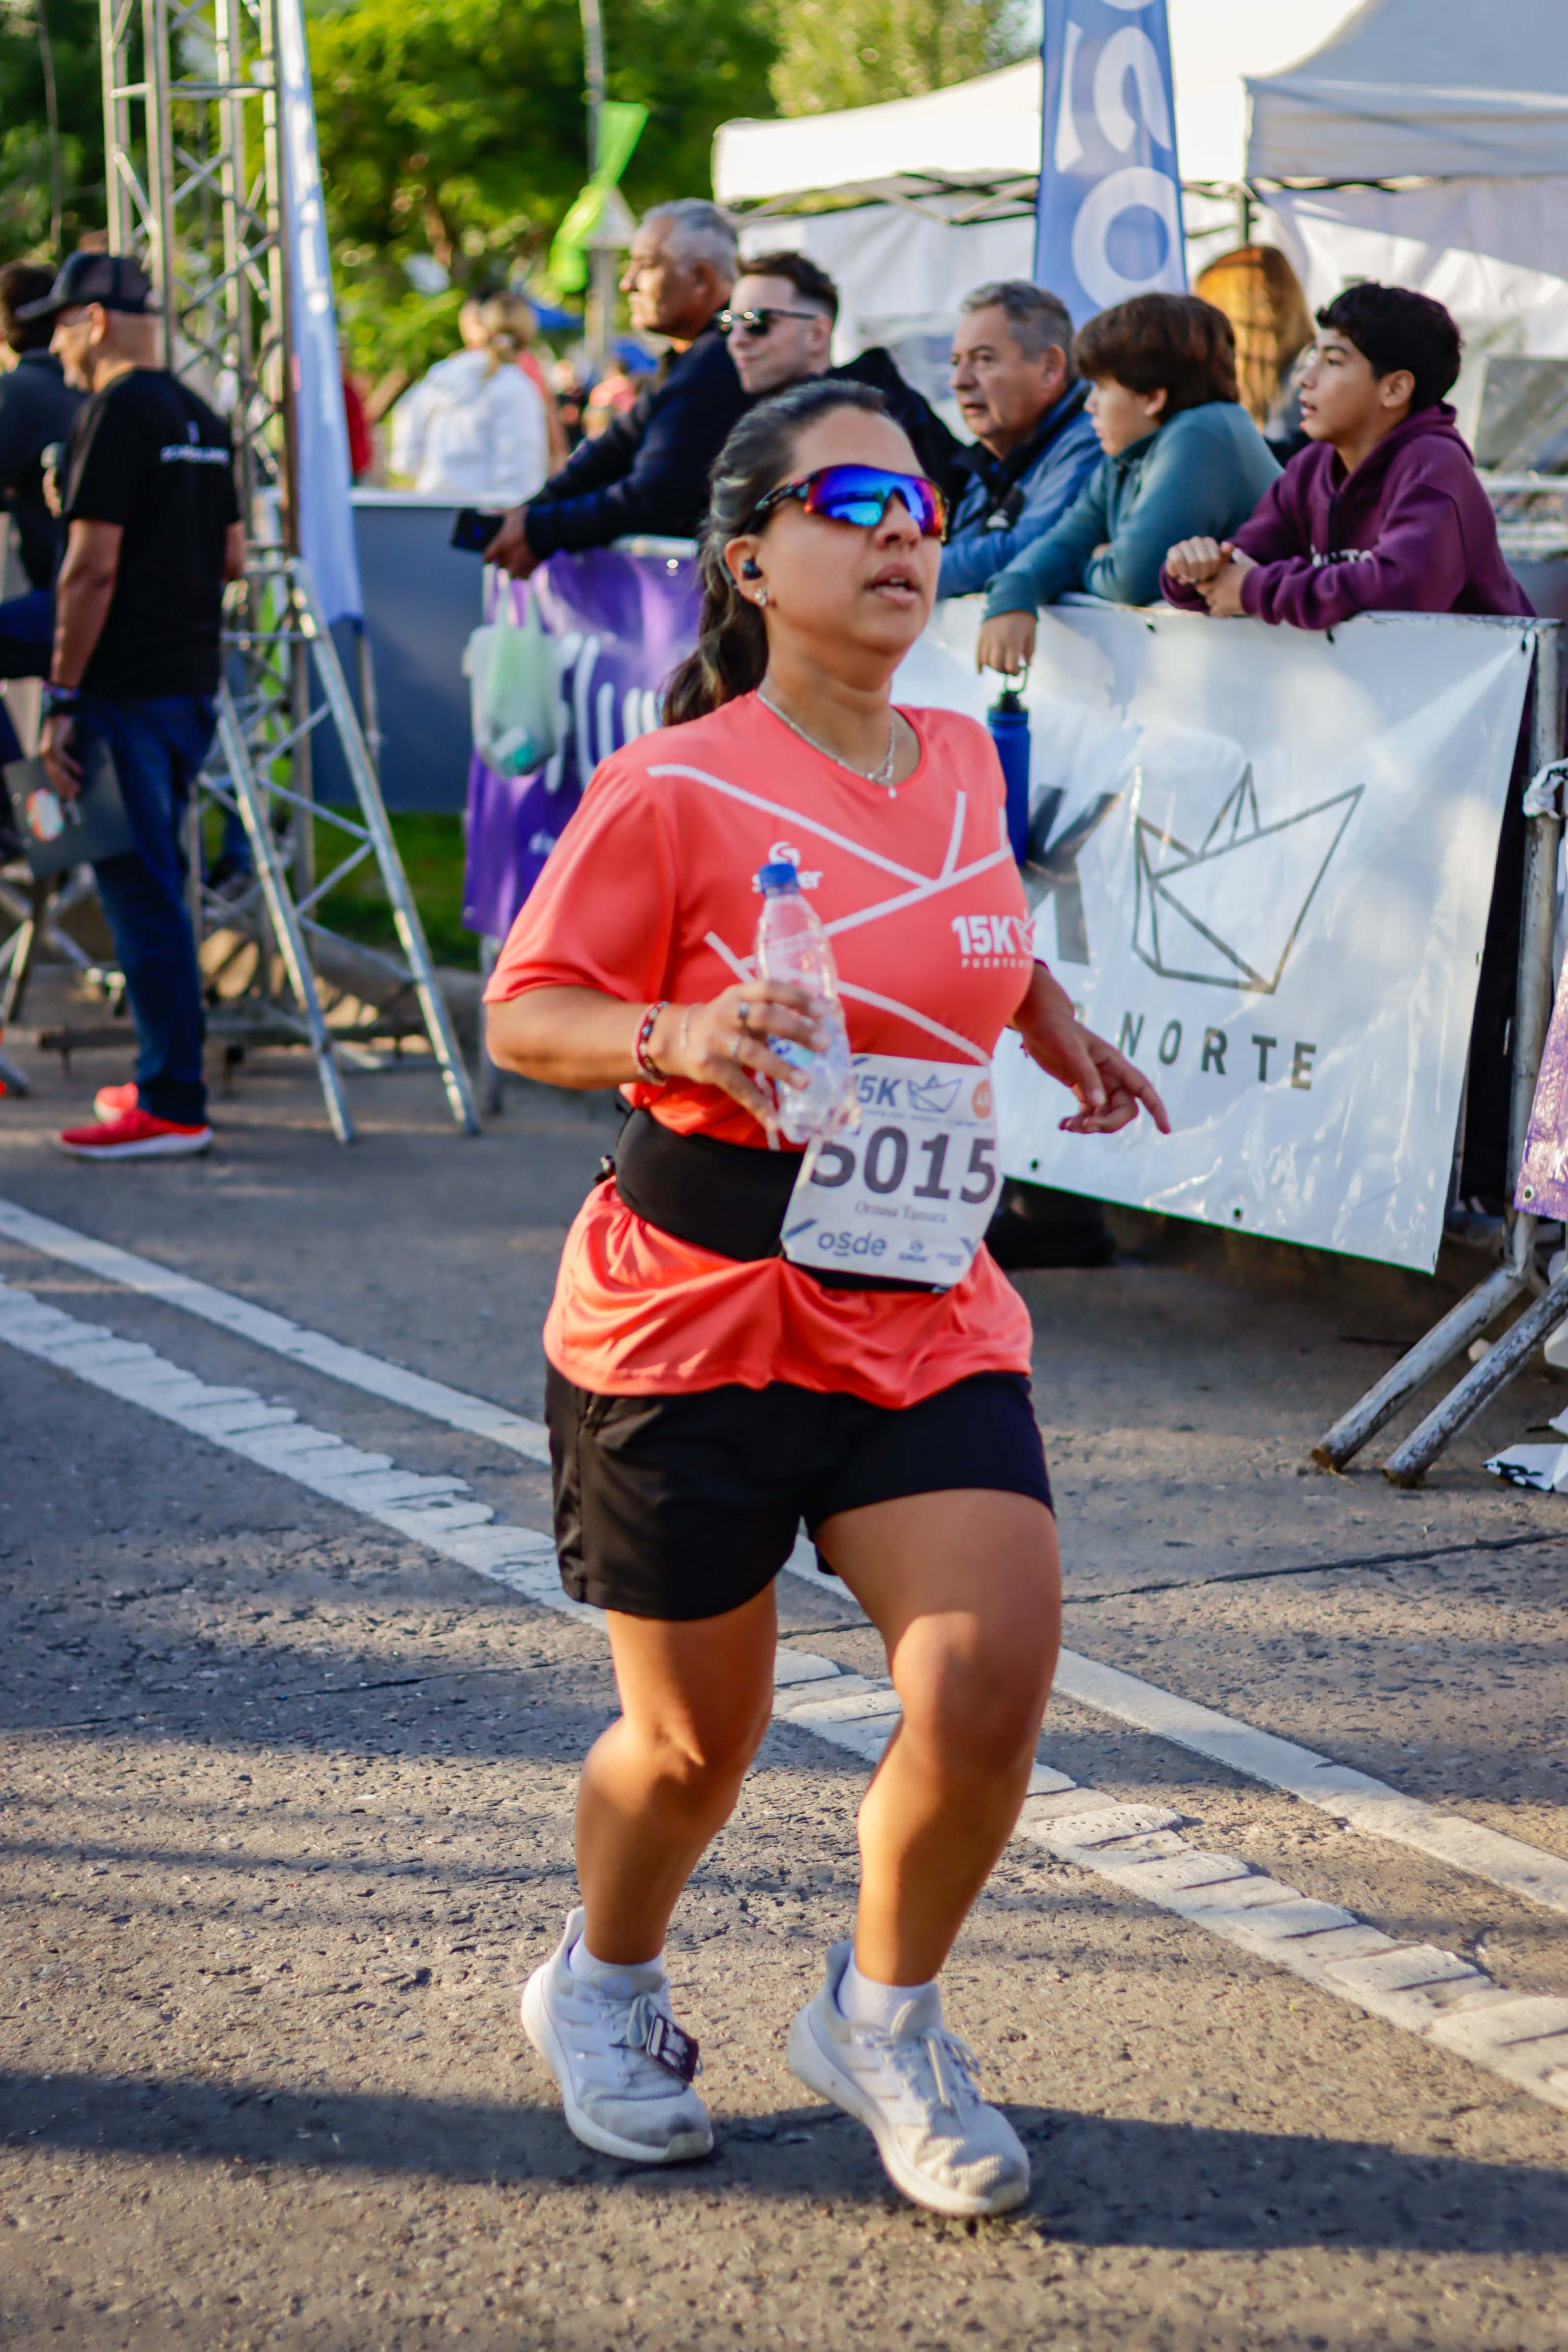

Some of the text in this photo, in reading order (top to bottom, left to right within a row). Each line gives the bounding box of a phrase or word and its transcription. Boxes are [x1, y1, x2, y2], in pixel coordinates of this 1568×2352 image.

[952, 915, 1015, 954] 15K
[1117, 1010, 1316, 1090] NORTE
[855, 1073, 901, 1106] 5K
[810, 1126, 996, 1204] 5015
[818, 1230, 887, 1257] osde
